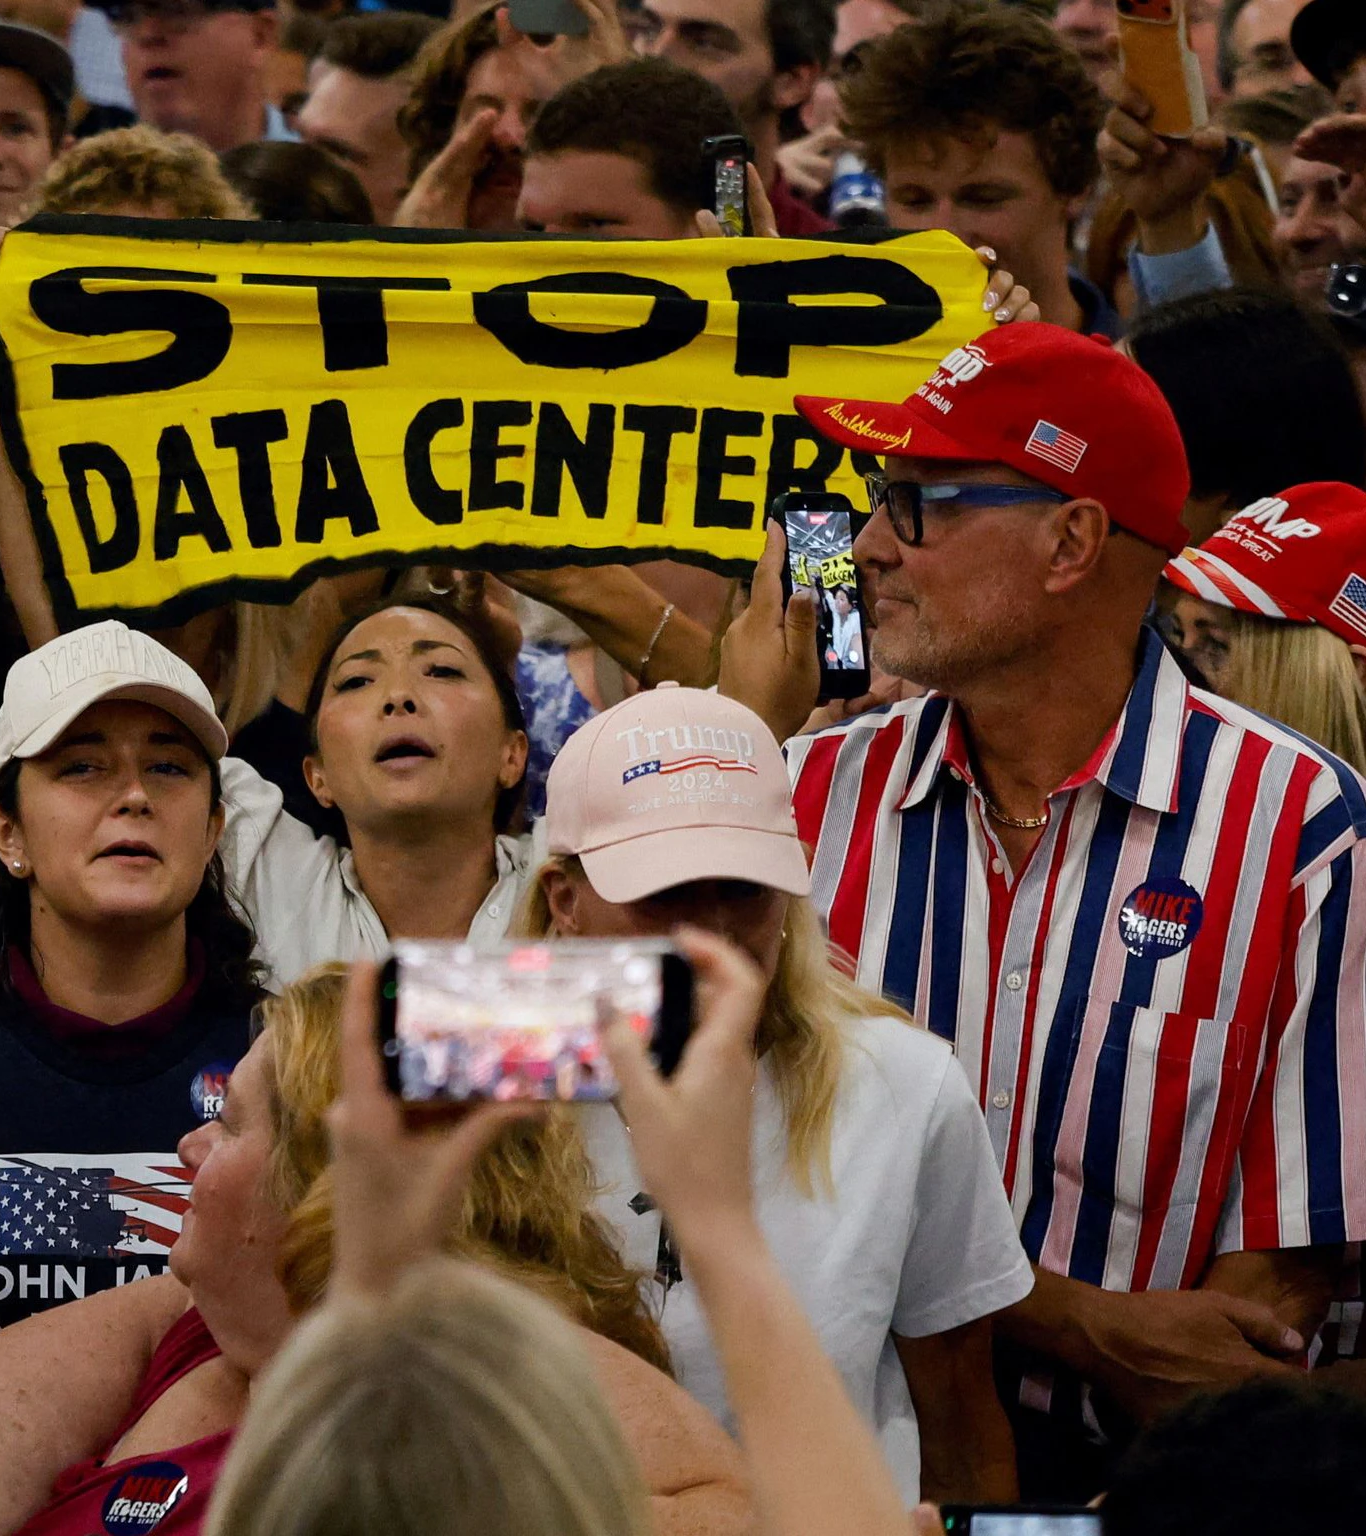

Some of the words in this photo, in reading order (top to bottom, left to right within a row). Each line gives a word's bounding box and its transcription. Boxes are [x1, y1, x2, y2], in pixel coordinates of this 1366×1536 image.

[28, 254, 944, 400] STOP
[58, 399, 380, 574] DATA
[1240, 539, 1276, 562] GREAT
[40, 628, 185, 698] YEEHAW
[616, 724, 755, 764] Trump
[667, 773, 729, 792] 2024
[1135, 888, 1196, 924] MIKE
[1126, 914, 1187, 941] ROGERS
[109, 1497, 168, 1518] ROGERS
